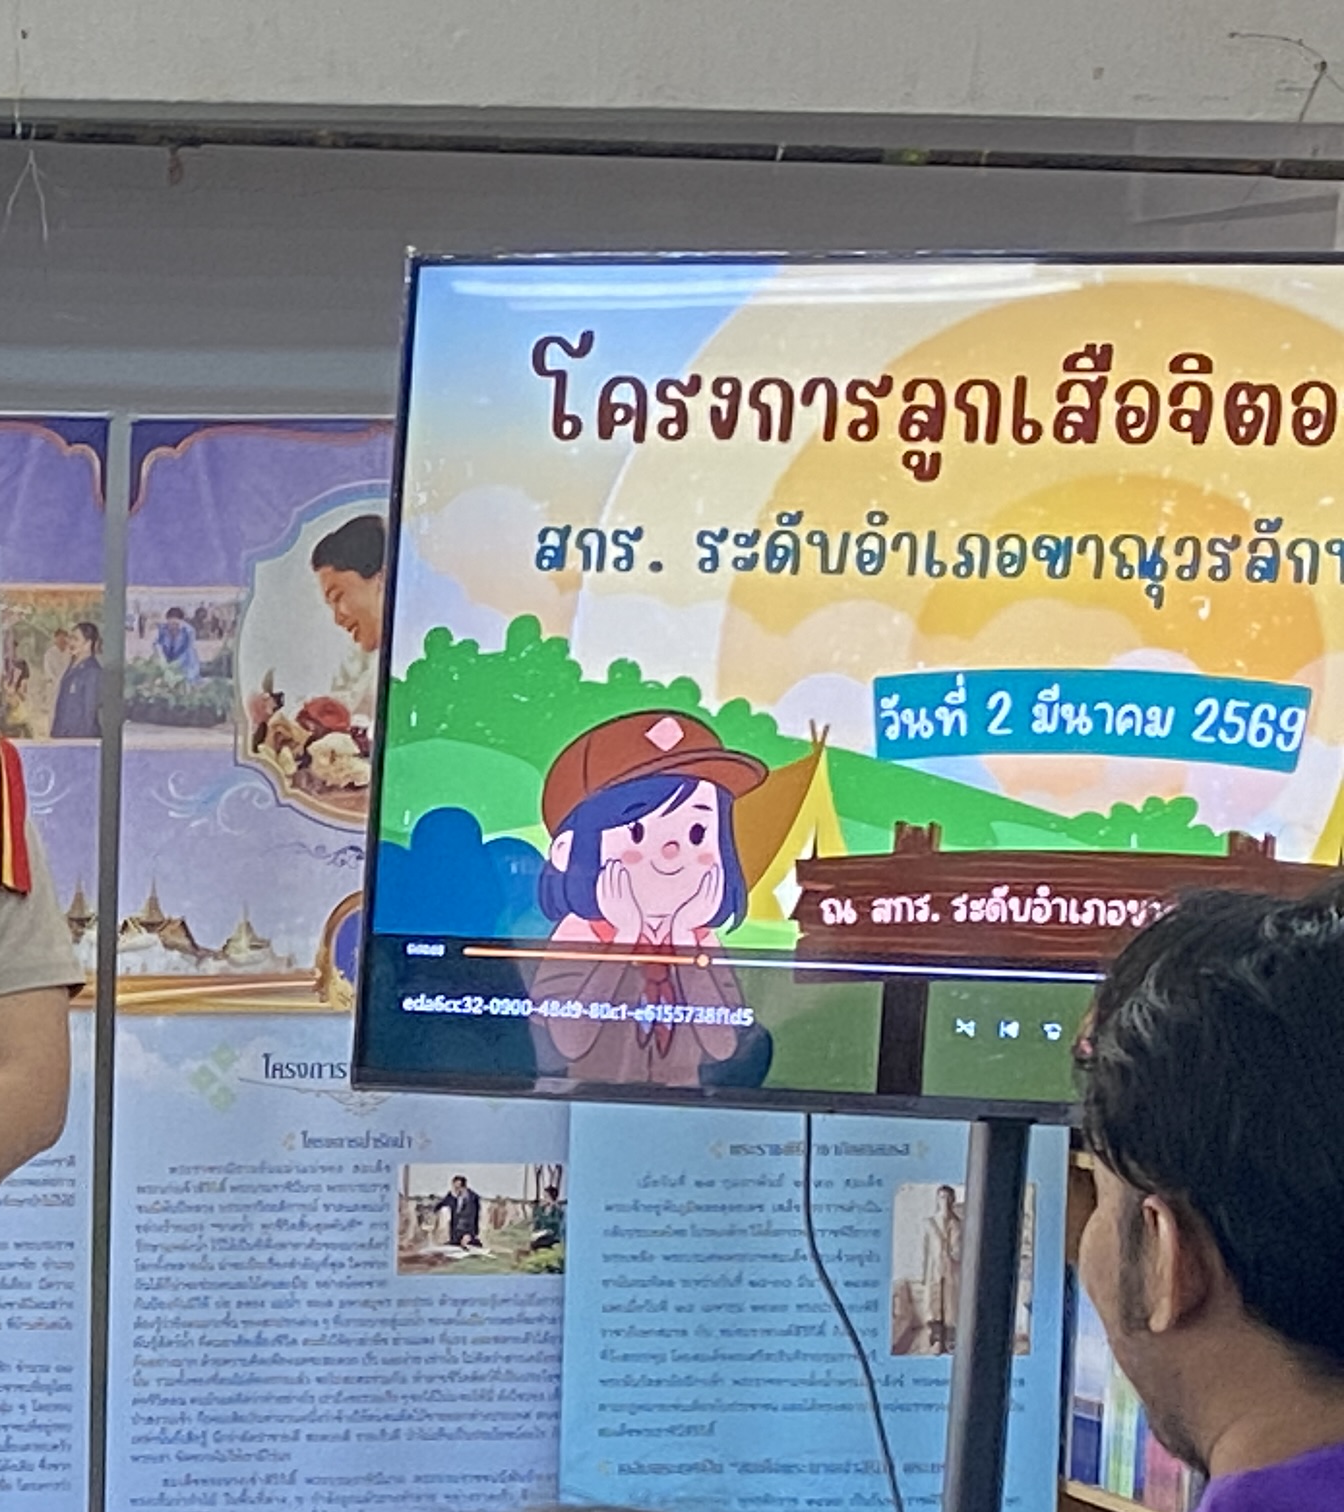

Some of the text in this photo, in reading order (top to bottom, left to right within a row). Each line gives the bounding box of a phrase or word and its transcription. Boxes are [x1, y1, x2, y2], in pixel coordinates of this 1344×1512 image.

[535, 522, 665, 575] สกร.
[879, 673, 1307, 753] วันที่ 2 มีนาคม 2569
[820, 898, 857, 925] ณ
[871, 896, 940, 924] สกร.
[262, 1052, 348, 1080] โครงการ
